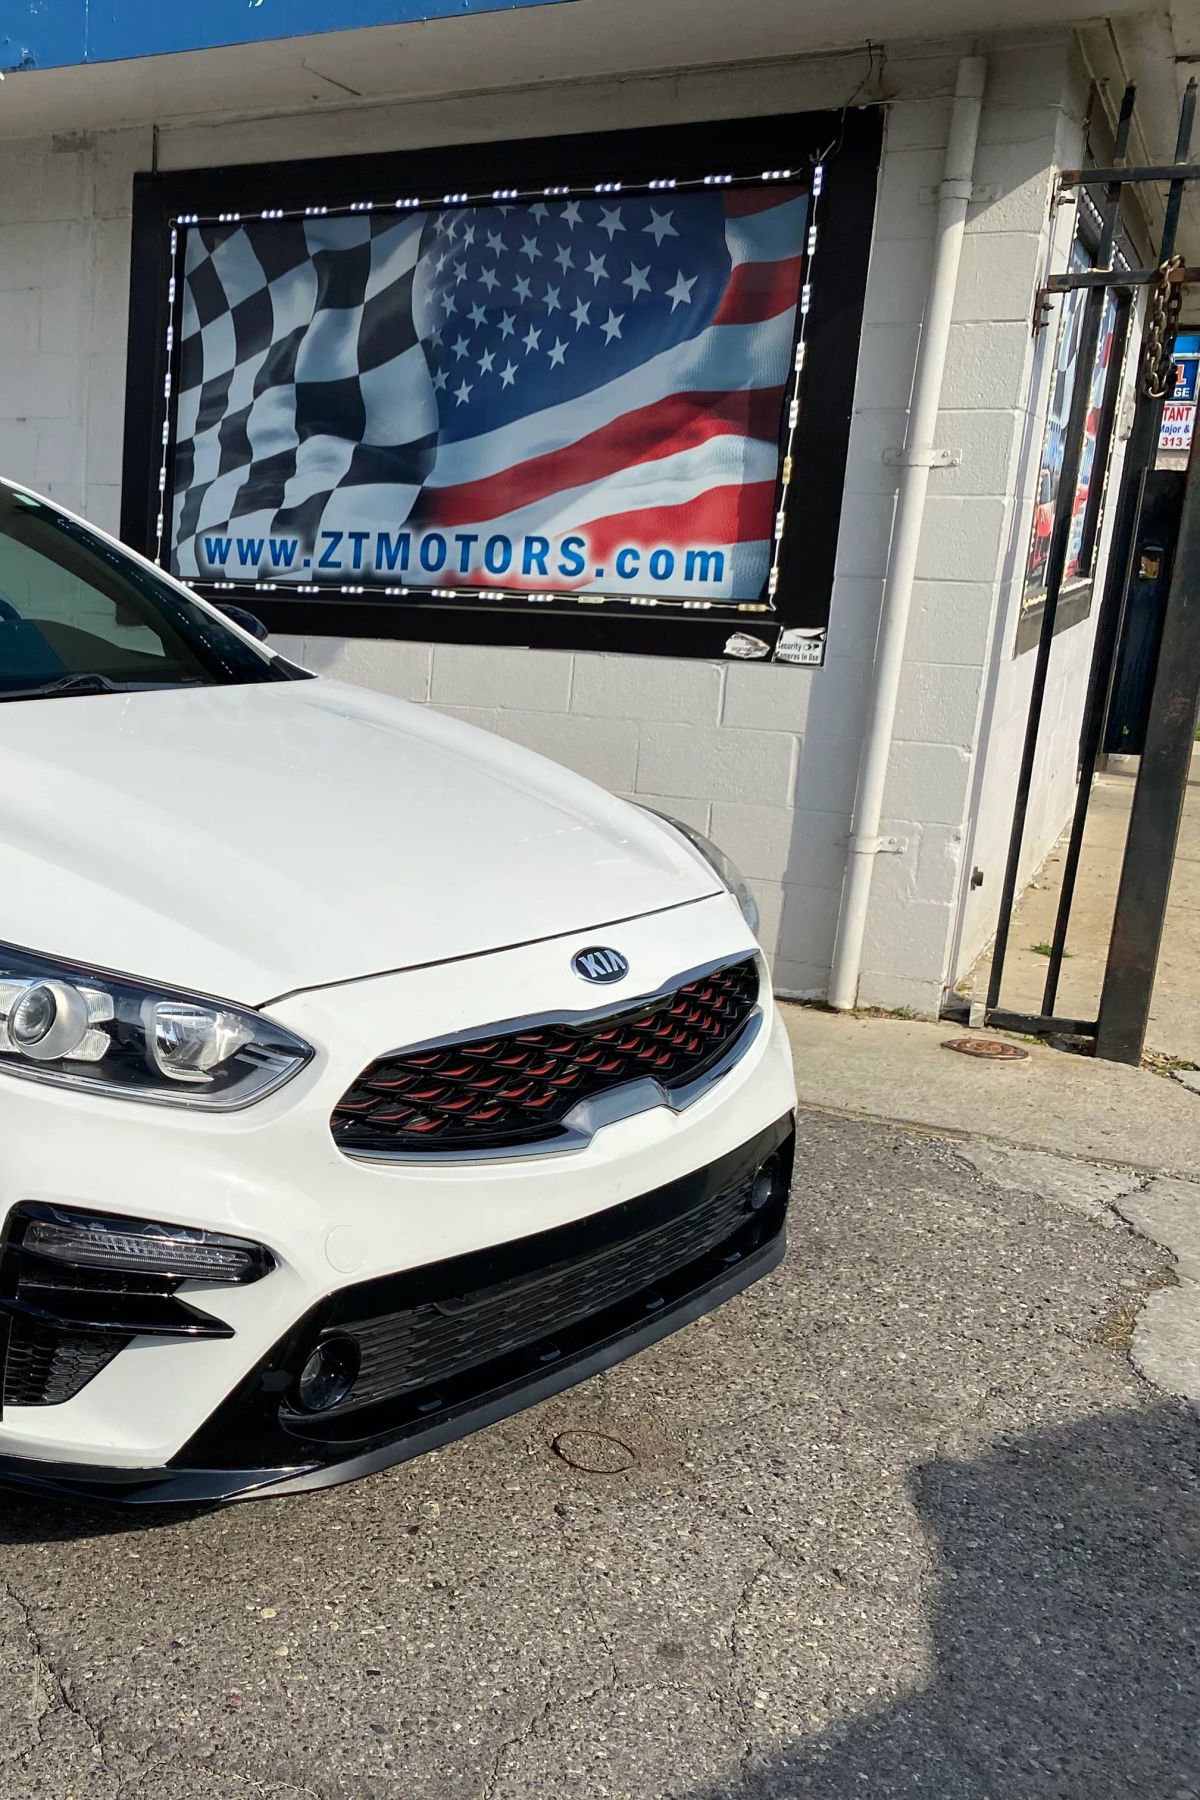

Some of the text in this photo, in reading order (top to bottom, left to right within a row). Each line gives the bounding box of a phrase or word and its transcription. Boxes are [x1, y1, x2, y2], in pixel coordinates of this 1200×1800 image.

[1162, 437, 1183, 447] 313
[204, 530, 725, 582] www.ZTMOTORS.com
[578, 949, 626, 978] KIA
